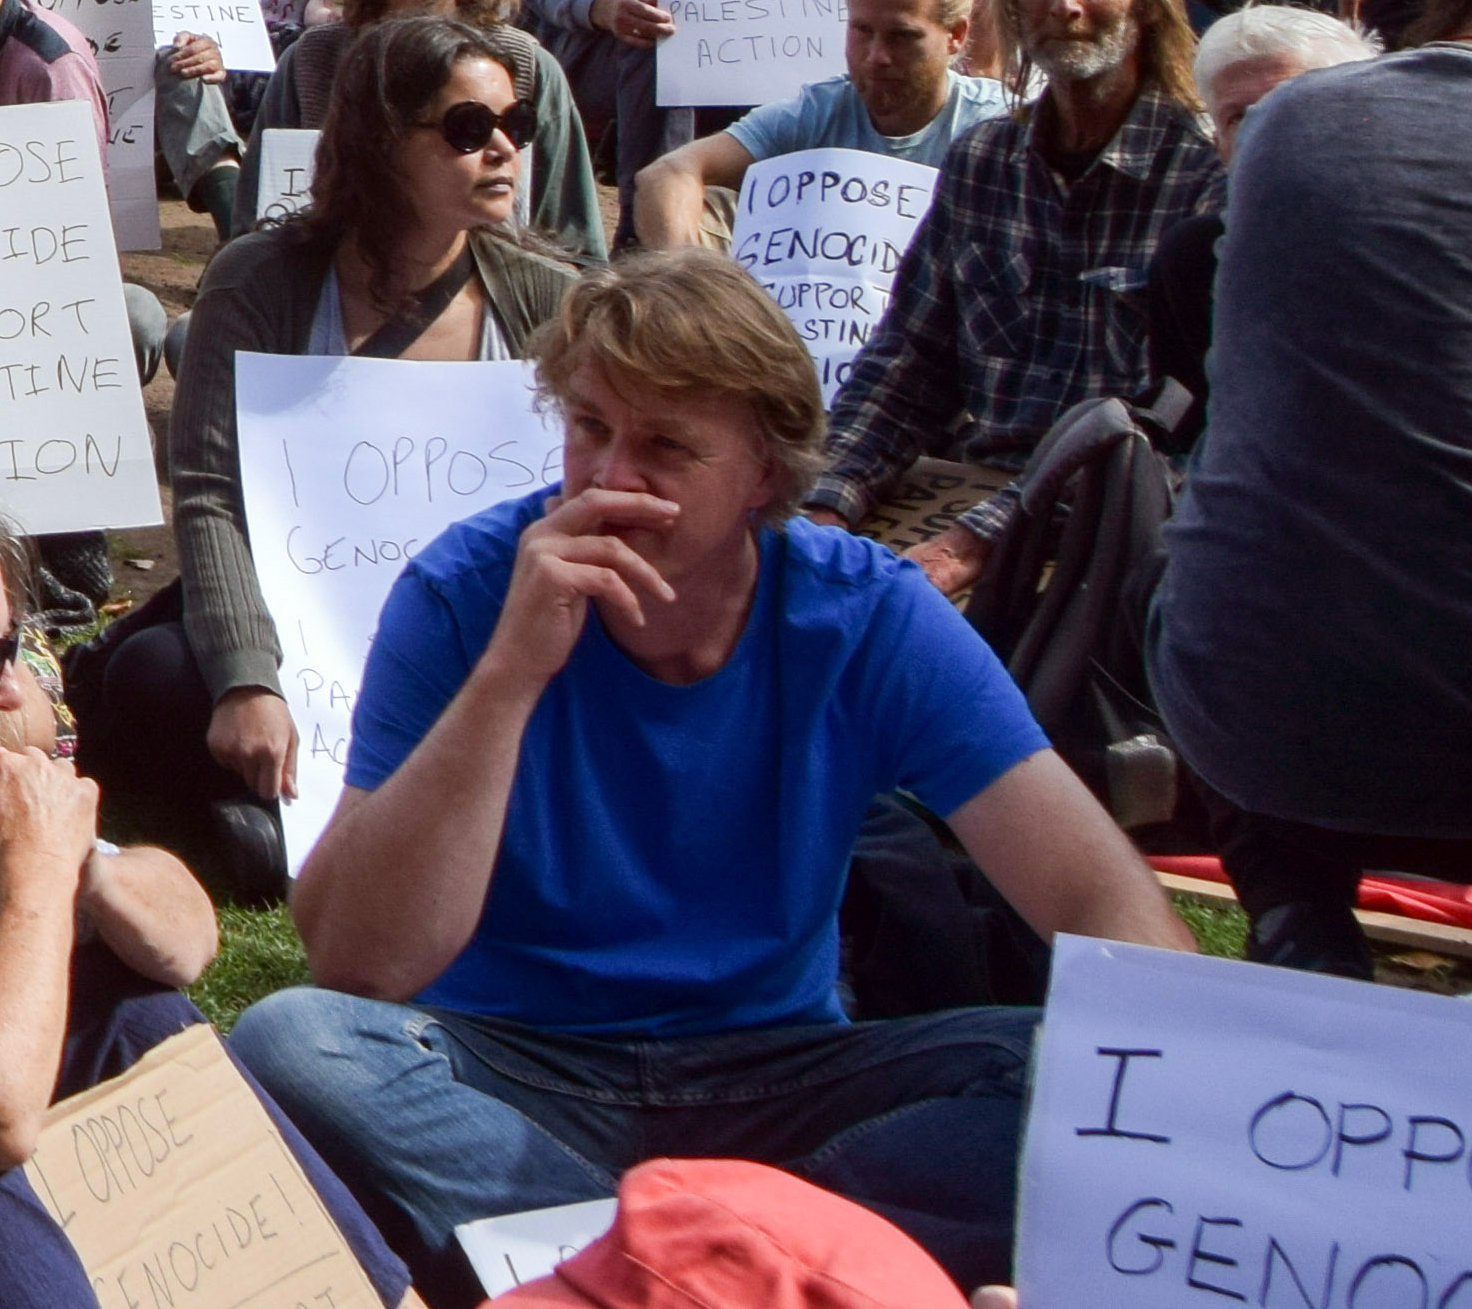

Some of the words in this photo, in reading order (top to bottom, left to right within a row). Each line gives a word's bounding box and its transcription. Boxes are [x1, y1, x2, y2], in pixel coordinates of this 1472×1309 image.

[151, 5, 255, 24] ESTINE
[696, 34, 825, 70] ACTION
[747, 177, 757, 216] I
[767, 171, 929, 220] OPPOSE
[735, 226, 904, 274] GENOCID
[283, 437, 299, 507] I
[1074, 1045, 1172, 1145] I
[1247, 1089, 1472, 1192] OPP
[70, 1088, 195, 1203] OPPOSE
